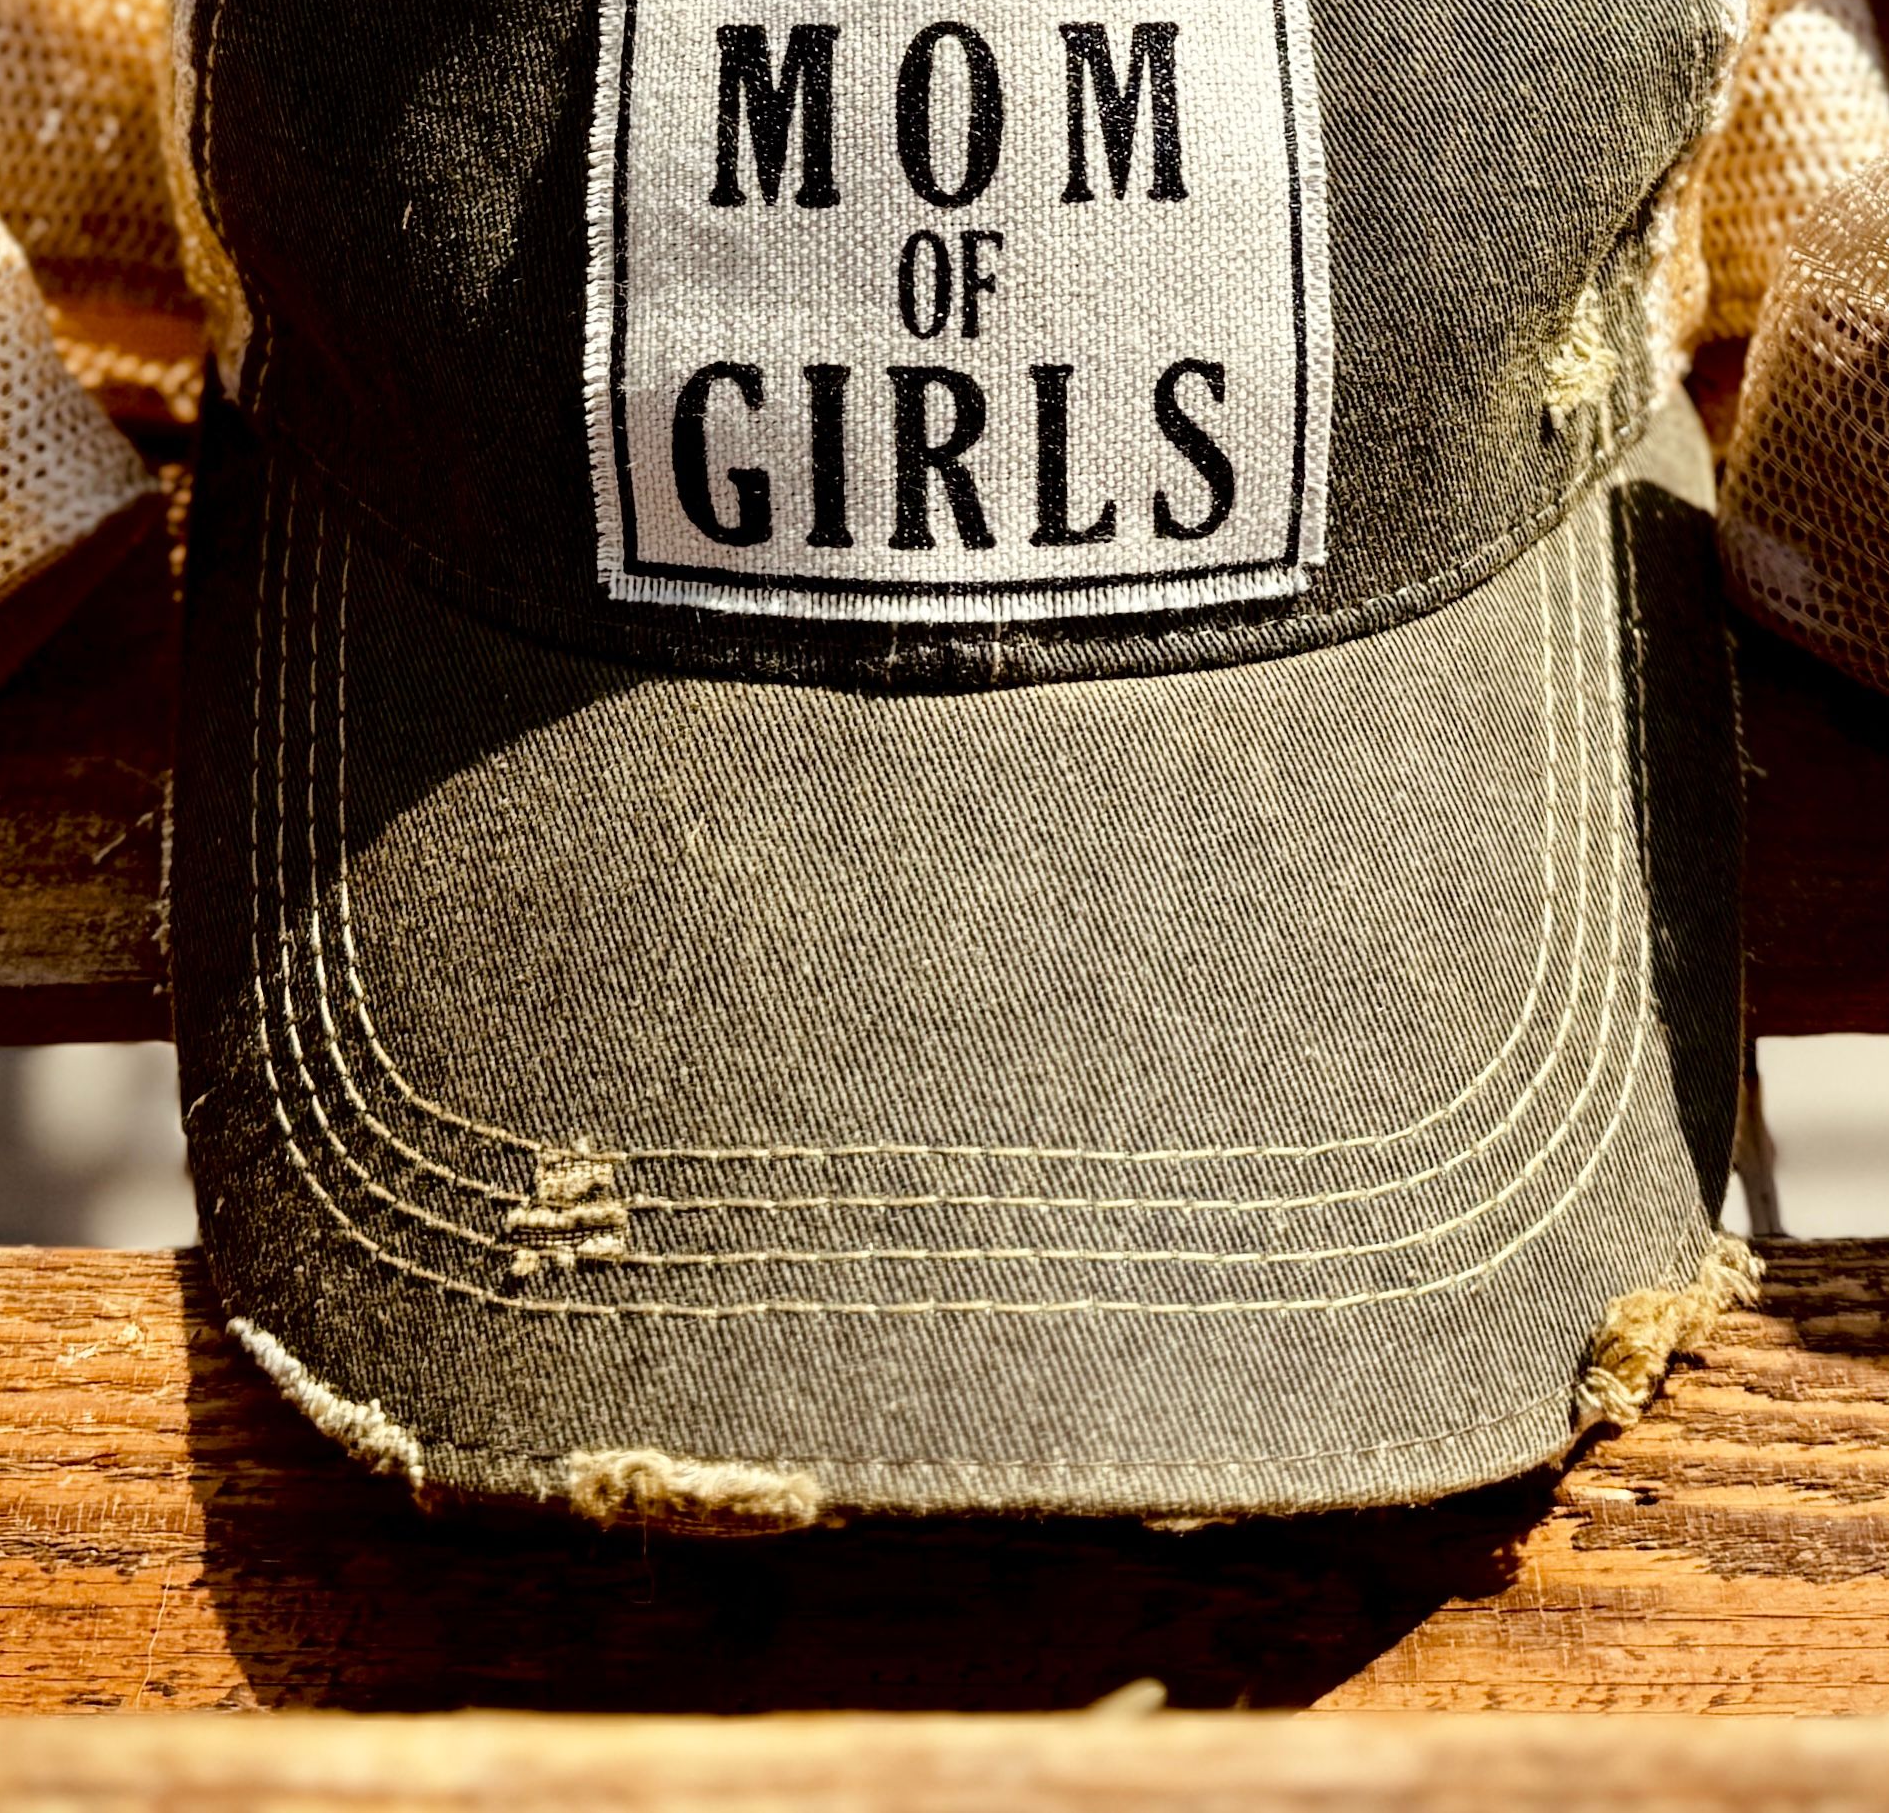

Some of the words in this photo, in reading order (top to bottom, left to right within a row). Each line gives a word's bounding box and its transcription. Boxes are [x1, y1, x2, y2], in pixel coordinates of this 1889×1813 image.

[710, 20, 1190, 209] MOM
[897, 229, 1004, 340] OF
[671, 357, 1236, 552] GIRLS
